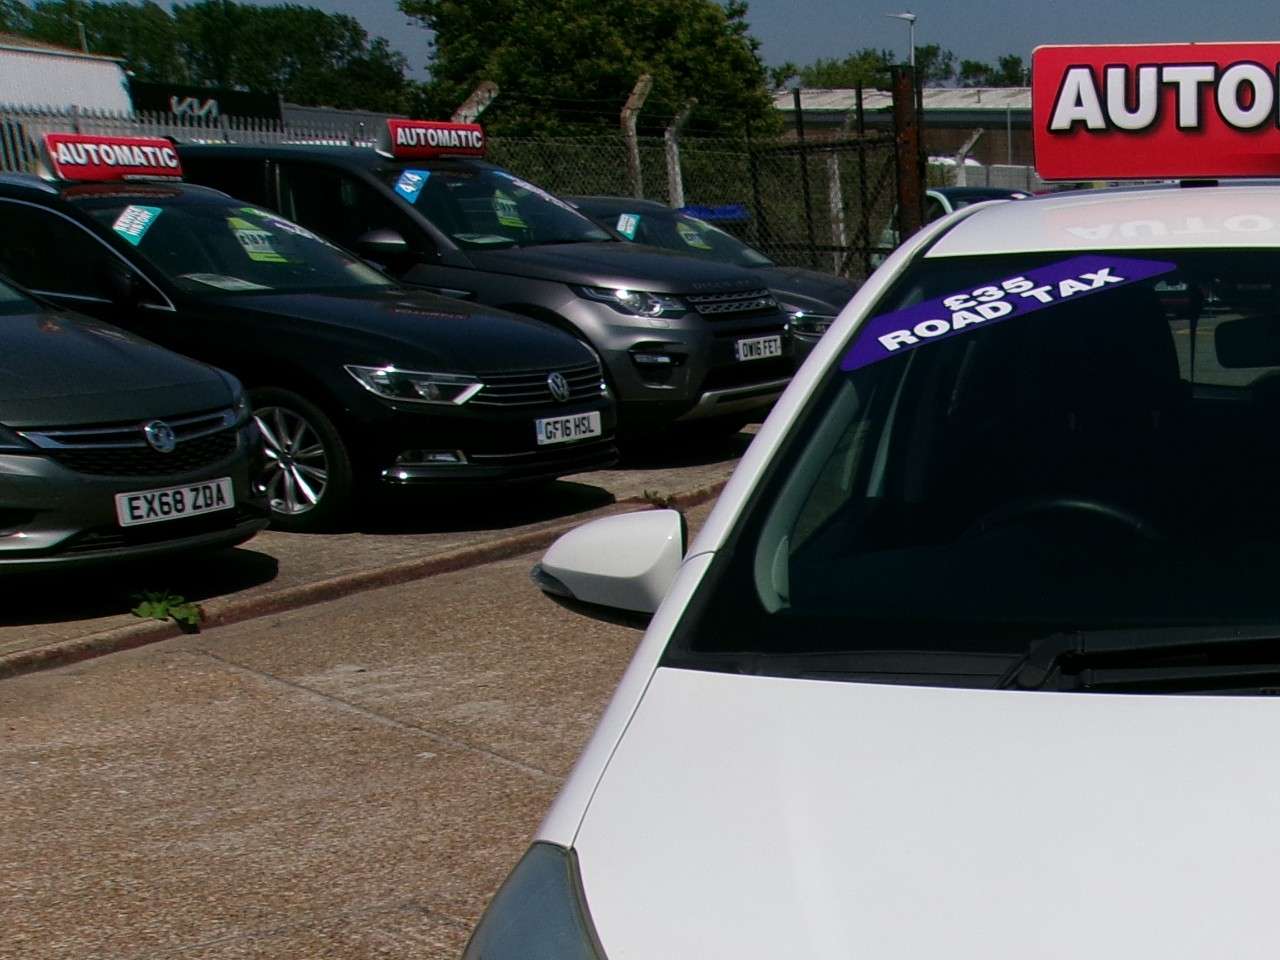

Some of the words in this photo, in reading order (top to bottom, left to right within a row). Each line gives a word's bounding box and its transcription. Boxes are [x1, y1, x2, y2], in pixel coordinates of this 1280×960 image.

[397, 127, 483, 148] AUTOMATIC
[55, 142, 178, 168] AUTOMATIC
[942, 275, 1035, 311] £35
[877, 300, 1013, 352] ROAD
[1020, 267, 1125, 304] TAX
[544, 419, 572, 441] GF16
[574, 416, 595, 436] HSL
[127, 490, 185, 521] EX68
[189, 482, 227, 511] ZDA
